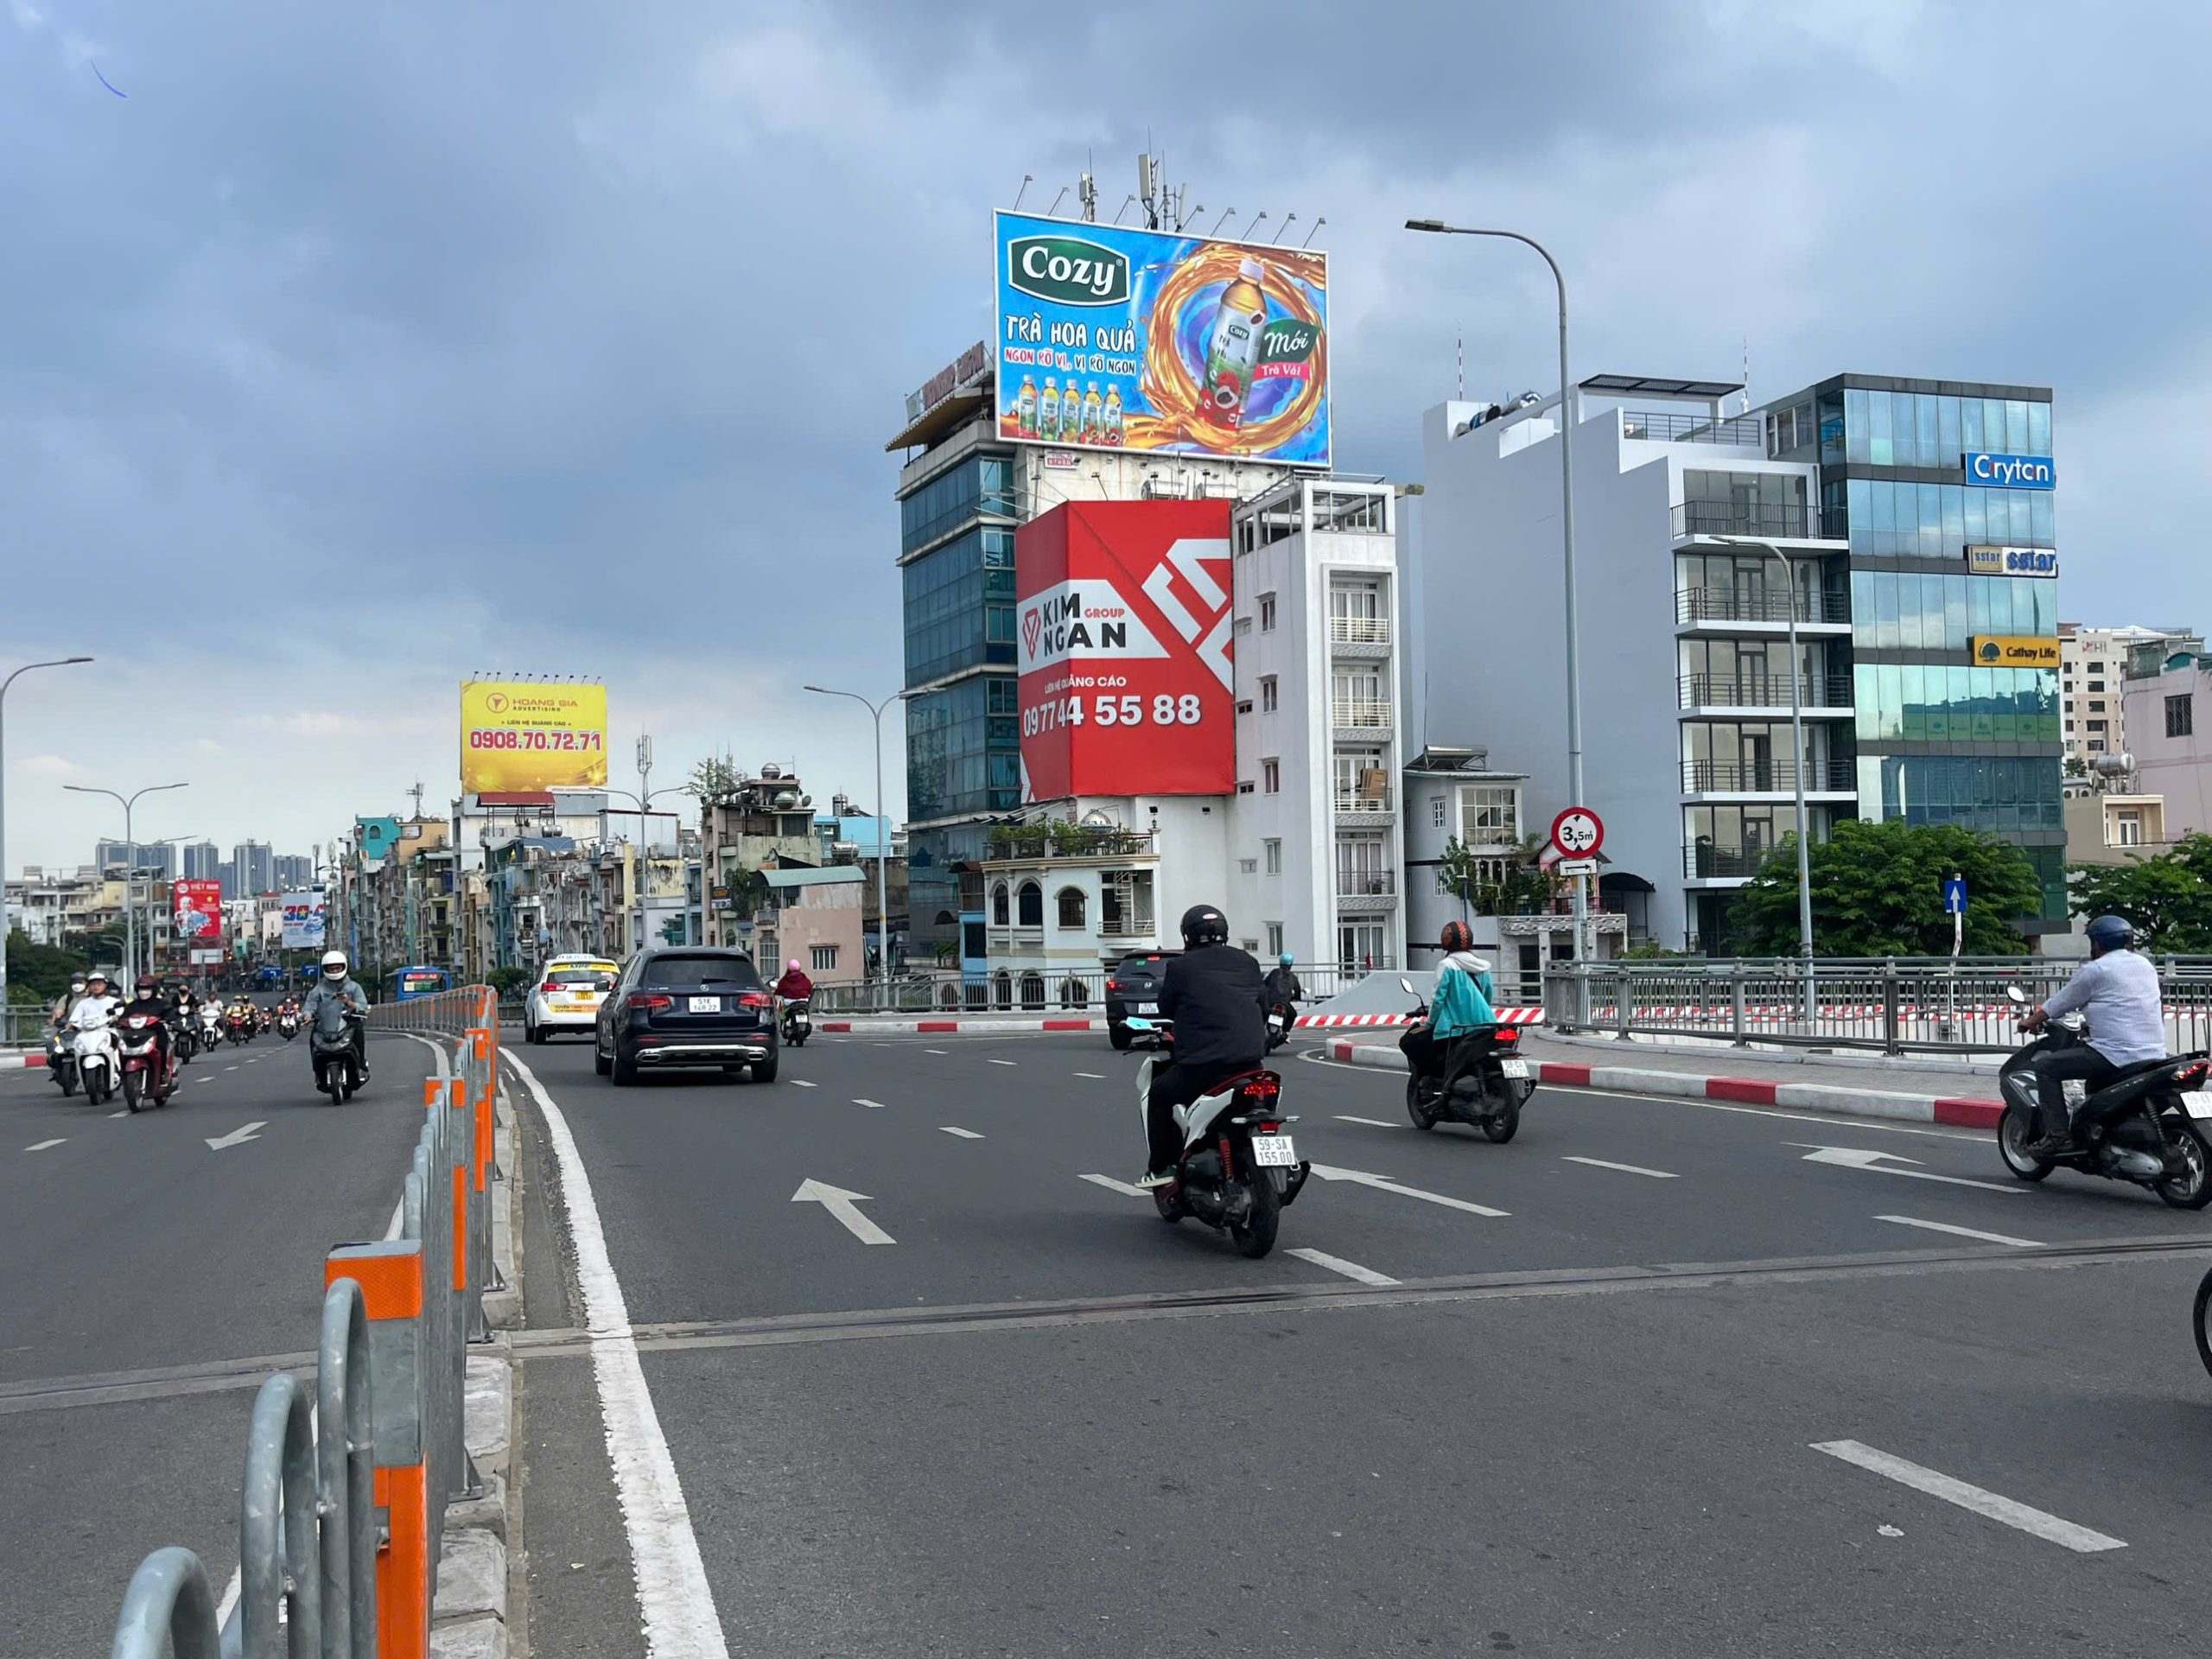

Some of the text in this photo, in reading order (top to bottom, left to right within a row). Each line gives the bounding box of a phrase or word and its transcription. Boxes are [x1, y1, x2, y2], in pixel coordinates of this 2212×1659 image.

[1022, 245, 1115, 296] Cozy
[1005, 312, 1136, 353] TRÀ HOA QUẢ
[1264, 330, 1308, 357] Mới
[1006, 348, 1033, 363] NGON
[1039, 349, 1052, 365] RÕ
[1075, 356, 1085, 372] VỊ
[1090, 355, 1103, 372] RÕ
[1108, 360, 1135, 374] NGON
[1262, 365, 1280, 376] Trà
[1975, 551, 2000, 562] sstar
[2007, 550, 2055, 571] sstar
[1044, 593, 1125, 628] KIM GROUP
[1044, 622, 1126, 657] NGAN
[2006, 646, 2056, 660] Cathay Life
[1061, 674, 1095, 689] QUẢNG
[1097, 675, 1127, 687] CÁO
[1095, 696, 1142, 726] 55
[1153, 694, 1201, 725] 88
[470, 731, 601, 751] 0908.70.72.71
[1563, 826, 1593, 845] 3,5m
[1258, 1138, 1287, 1150] 59-SA
